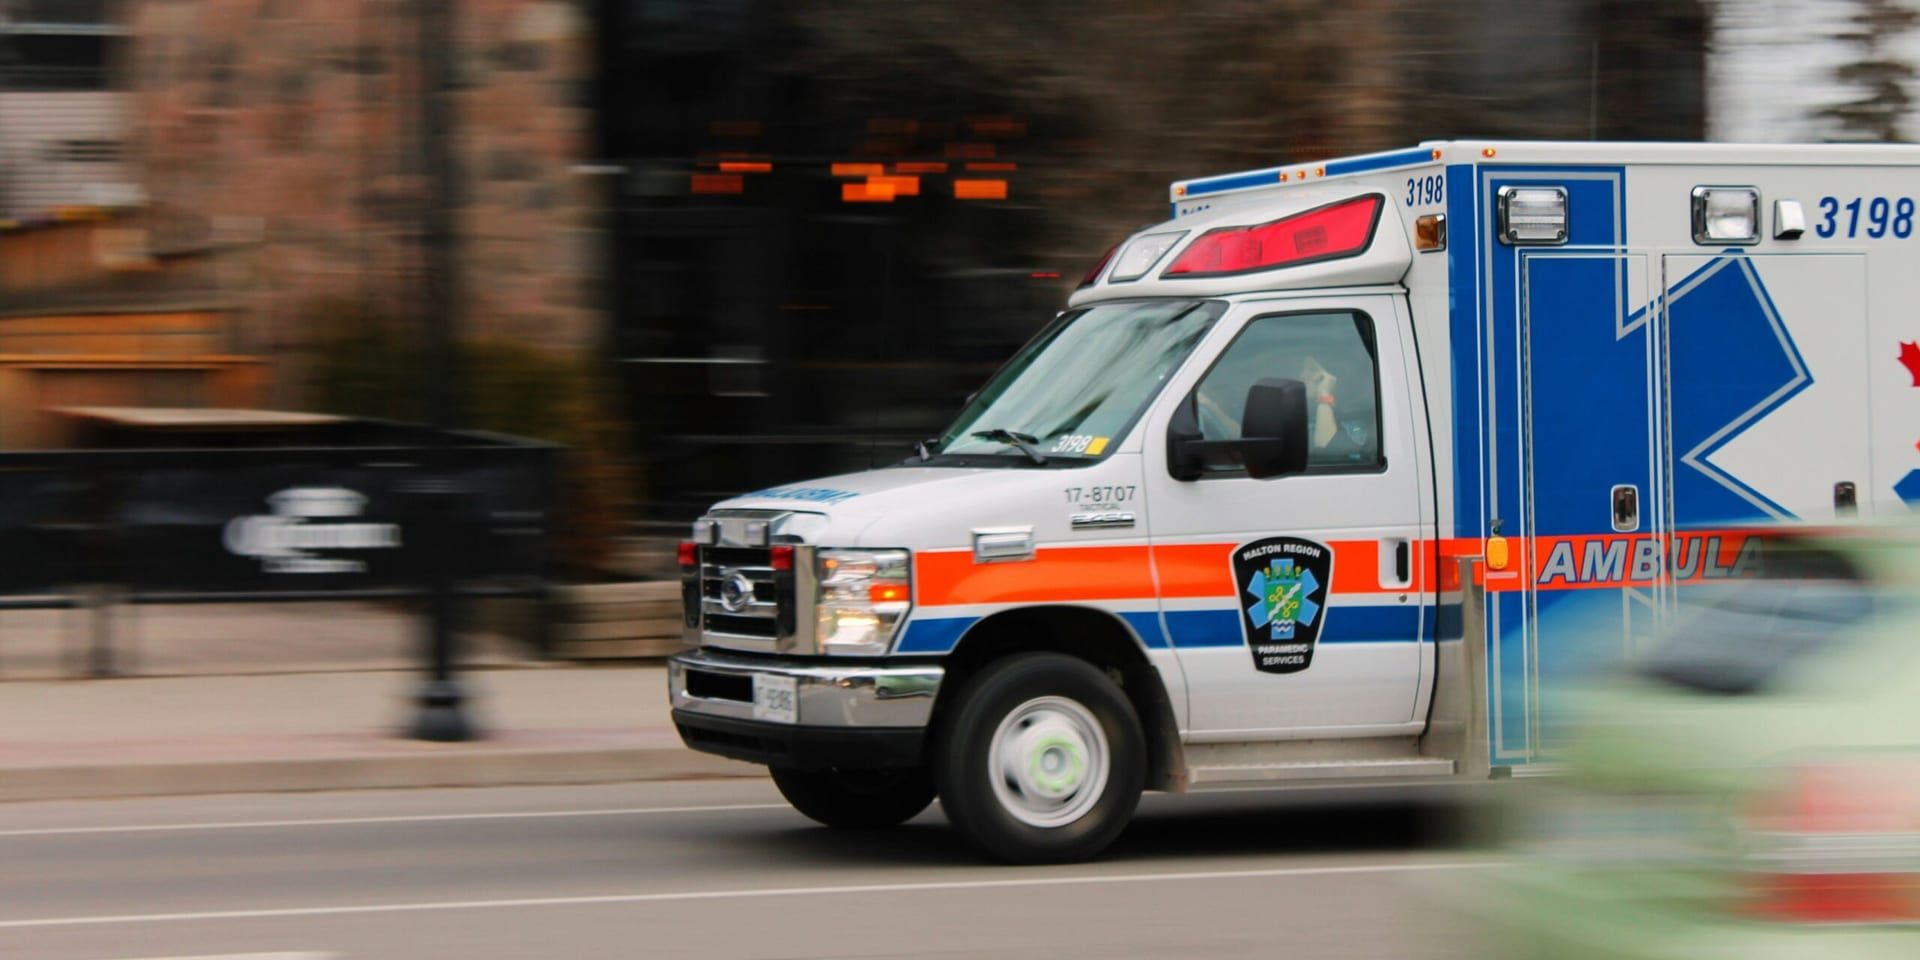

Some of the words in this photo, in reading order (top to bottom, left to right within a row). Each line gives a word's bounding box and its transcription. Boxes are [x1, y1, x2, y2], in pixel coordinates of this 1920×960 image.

[1406, 175, 1443, 207] 3198
[1815, 196, 1915, 238] 3198
[1051, 435, 1093, 453] 3198
[1064, 486, 1136, 502] 17-8707
[1243, 545, 1282, 560] HALTON
[1283, 544, 1321, 558] REGION
[1537, 537, 1766, 584] AMBULA
[1258, 643, 1308, 655] PARAMEDIC
[1262, 655, 1305, 666] SERVICES
